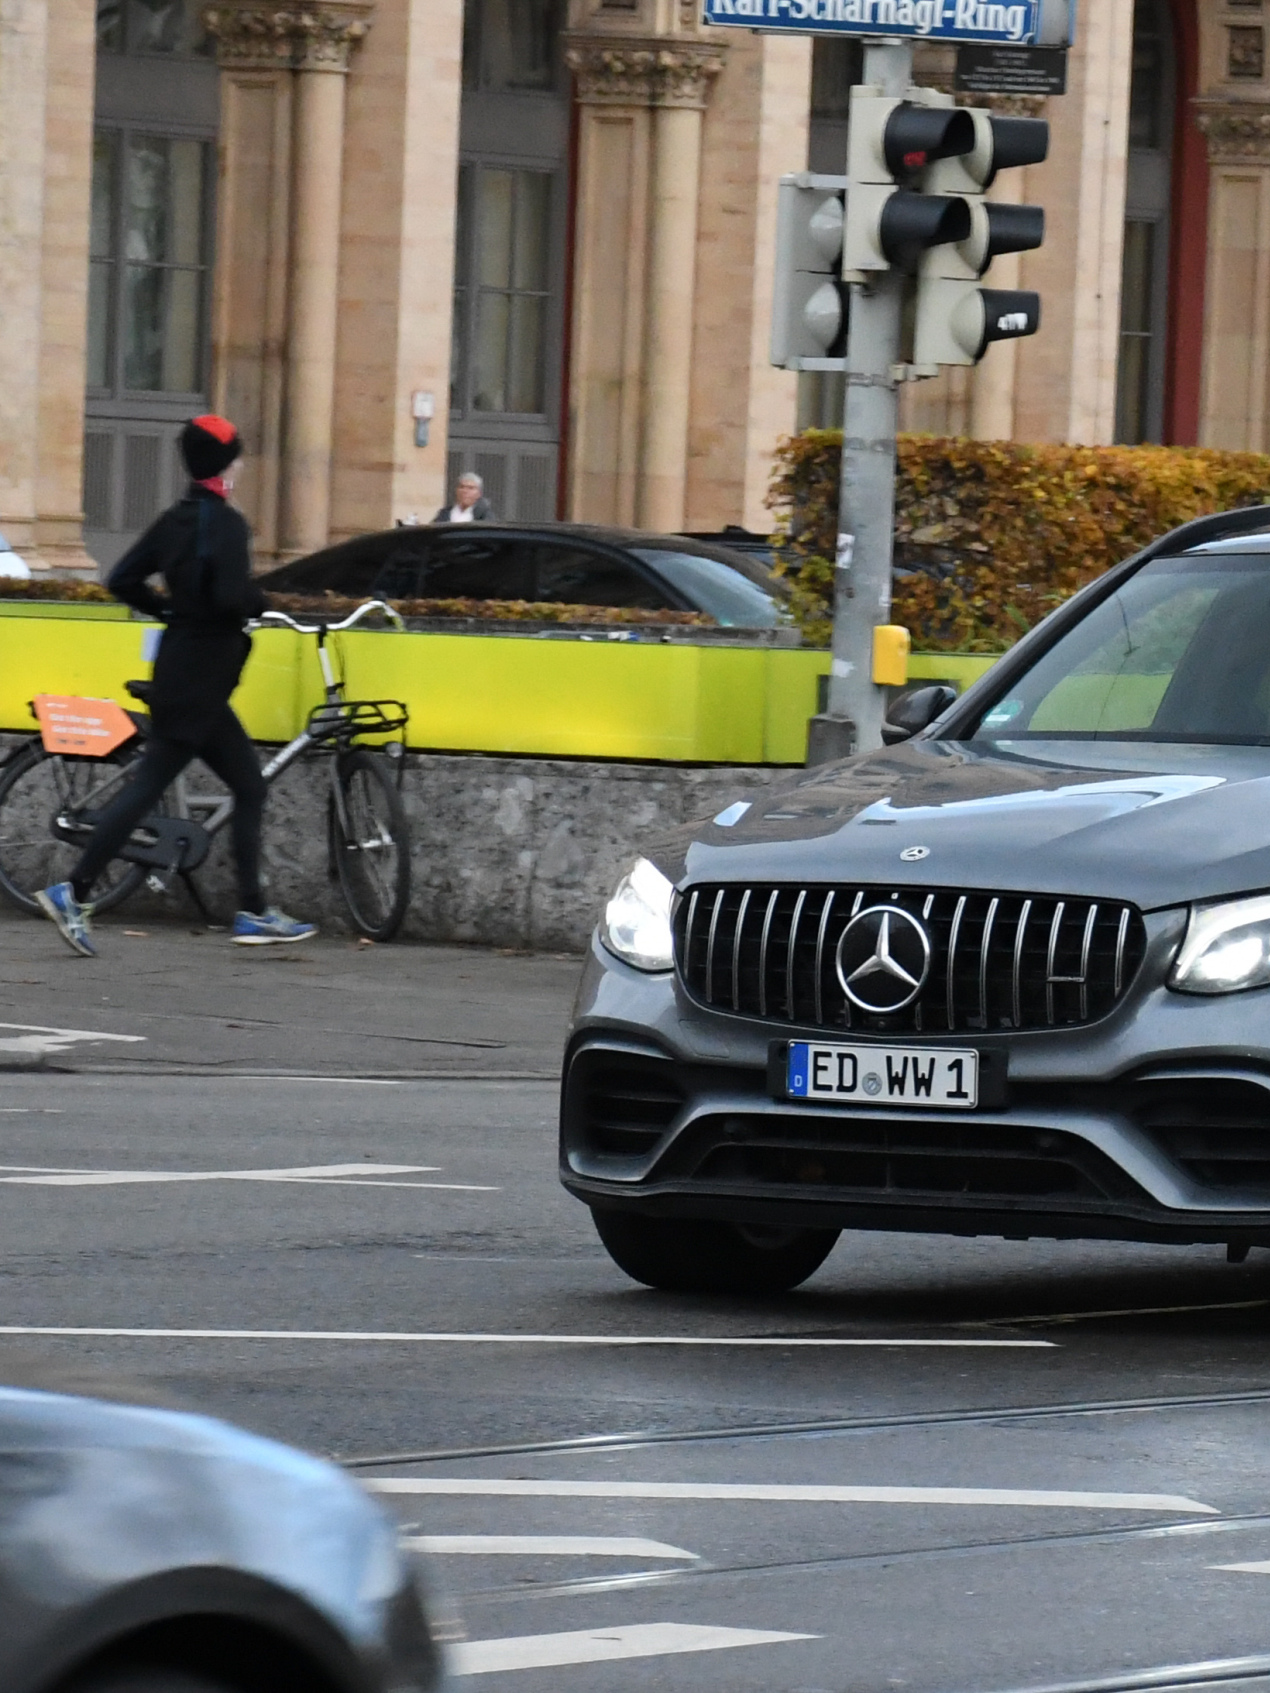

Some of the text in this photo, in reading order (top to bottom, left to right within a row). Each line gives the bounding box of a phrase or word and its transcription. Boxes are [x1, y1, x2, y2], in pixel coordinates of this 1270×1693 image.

[793, 1075, 803, 1087] D
[812, 1051, 969, 1099] ED WW 1
